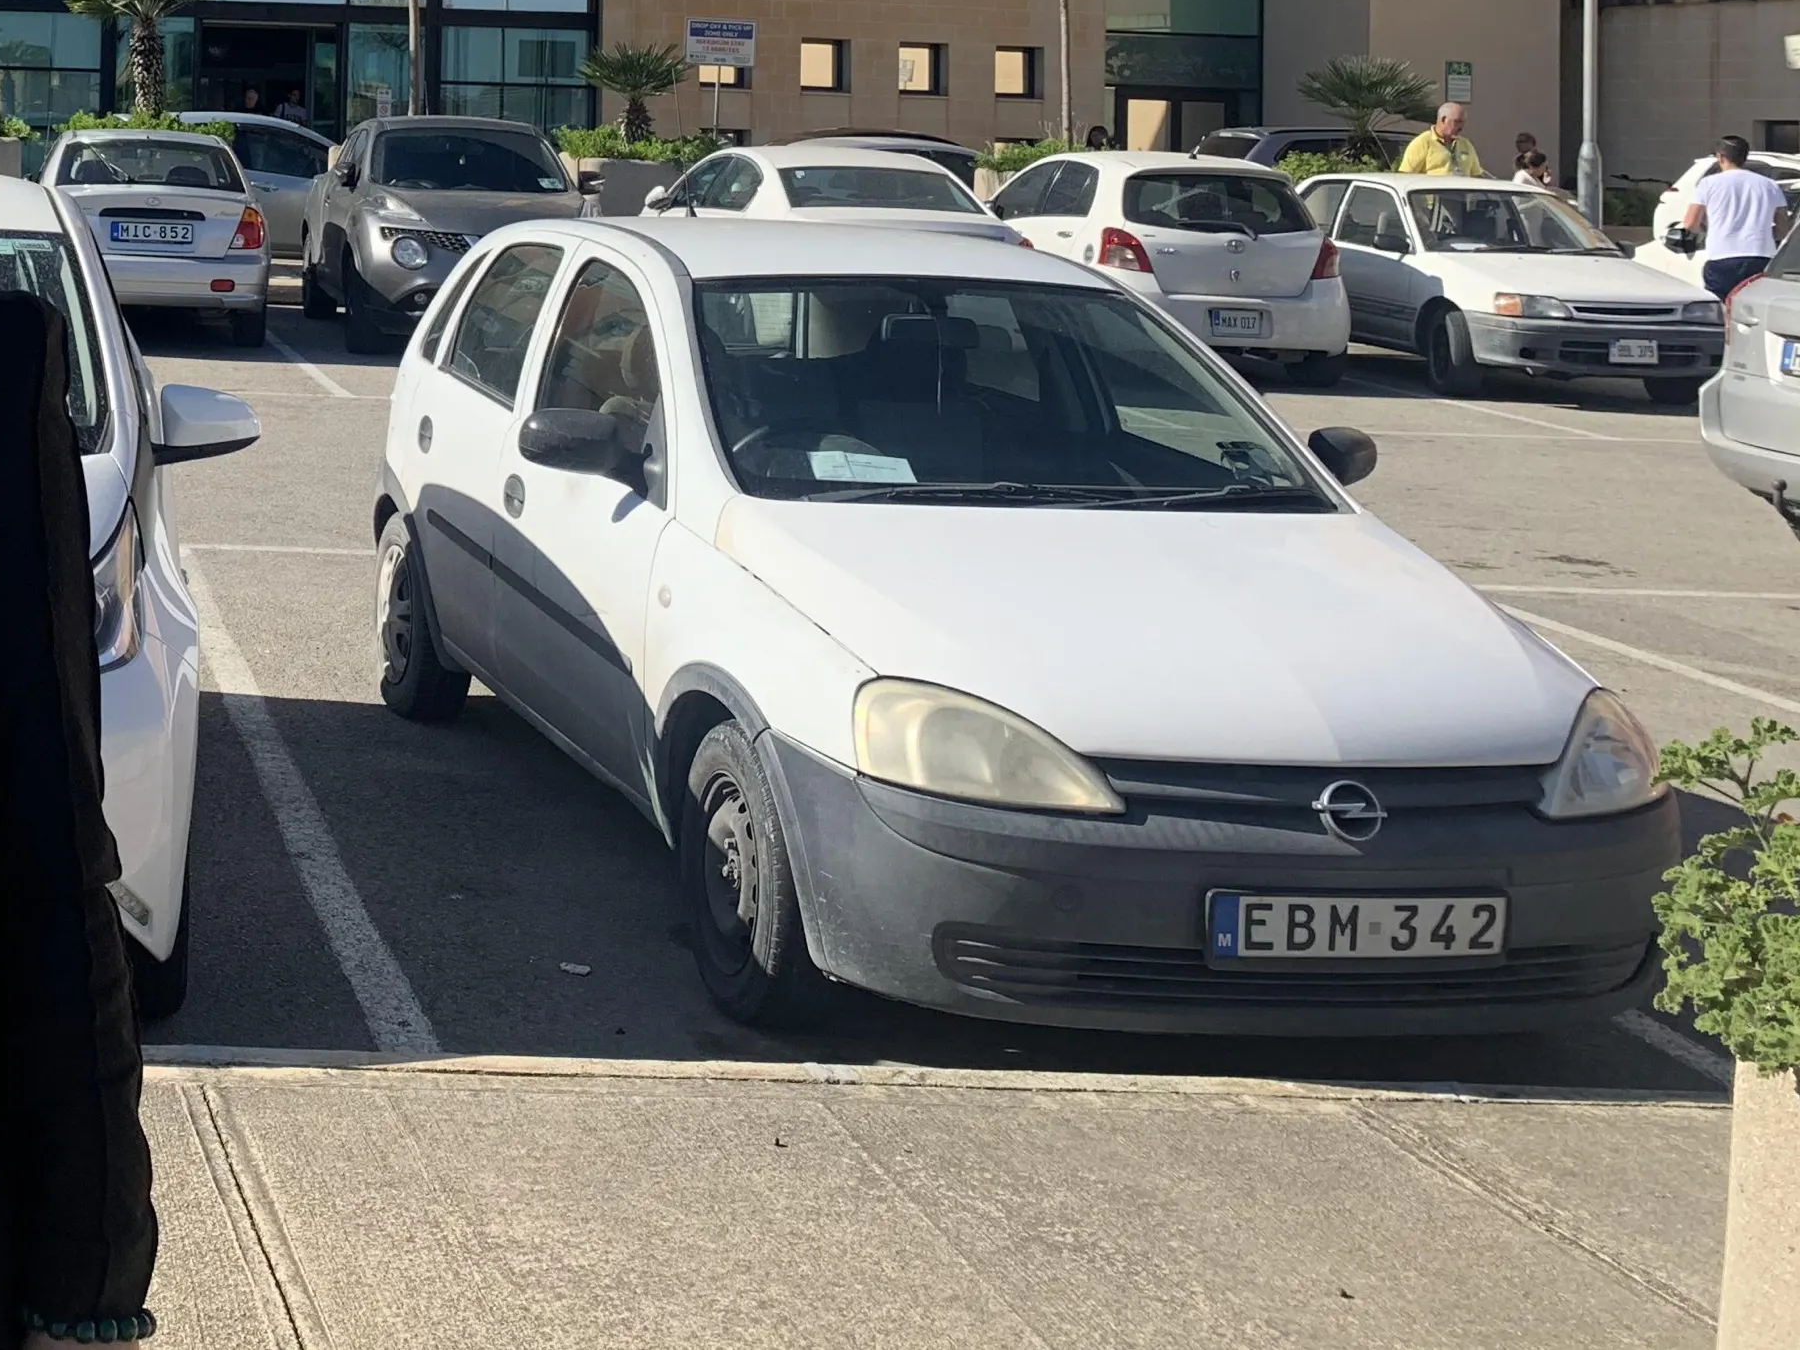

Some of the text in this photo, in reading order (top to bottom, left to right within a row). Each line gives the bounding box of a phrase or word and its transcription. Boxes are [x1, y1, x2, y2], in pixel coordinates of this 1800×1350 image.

[158, 226, 190, 240] 852
[1240, 316, 1257, 329] 017
[1218, 902, 1498, 952] M EBM 342
